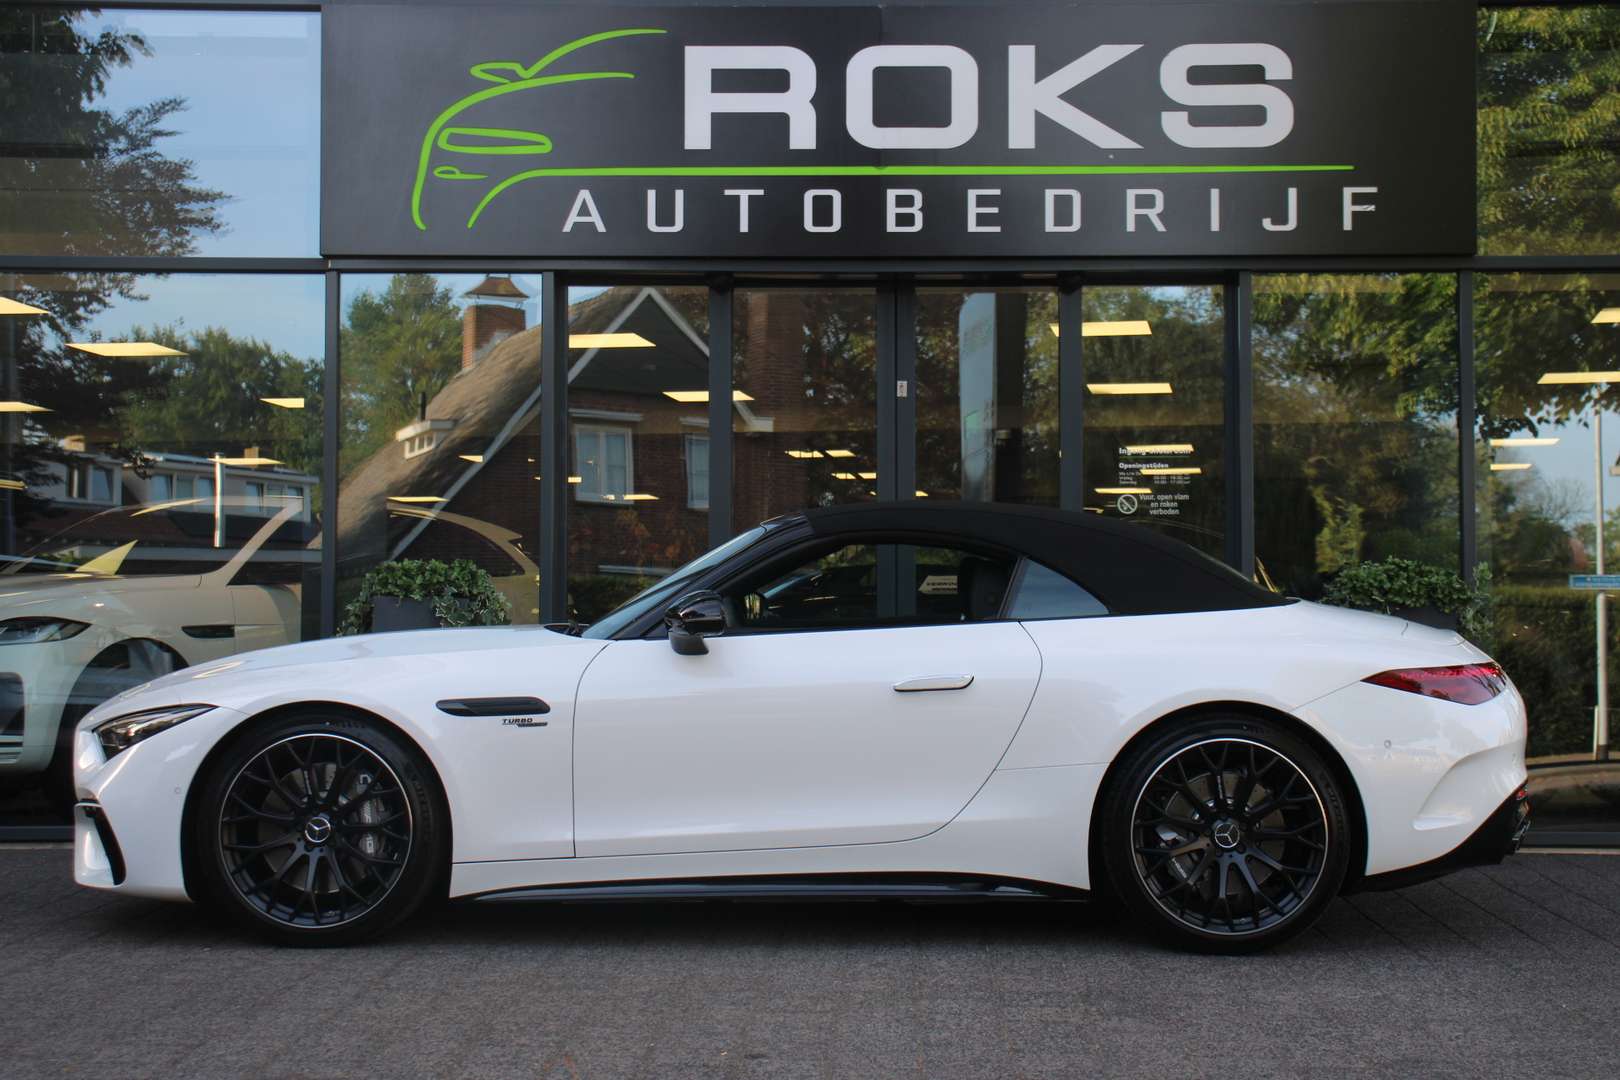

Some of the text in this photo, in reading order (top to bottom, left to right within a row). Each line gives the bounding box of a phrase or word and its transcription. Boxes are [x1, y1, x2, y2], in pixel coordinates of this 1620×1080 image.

[684, 42, 1295, 151] ROKS
[562, 186, 1378, 233] AUTOBEDRIJF
[1139, 493, 1190, 502] Vuur, open vlam
[1149, 508, 1180, 516] verboden
